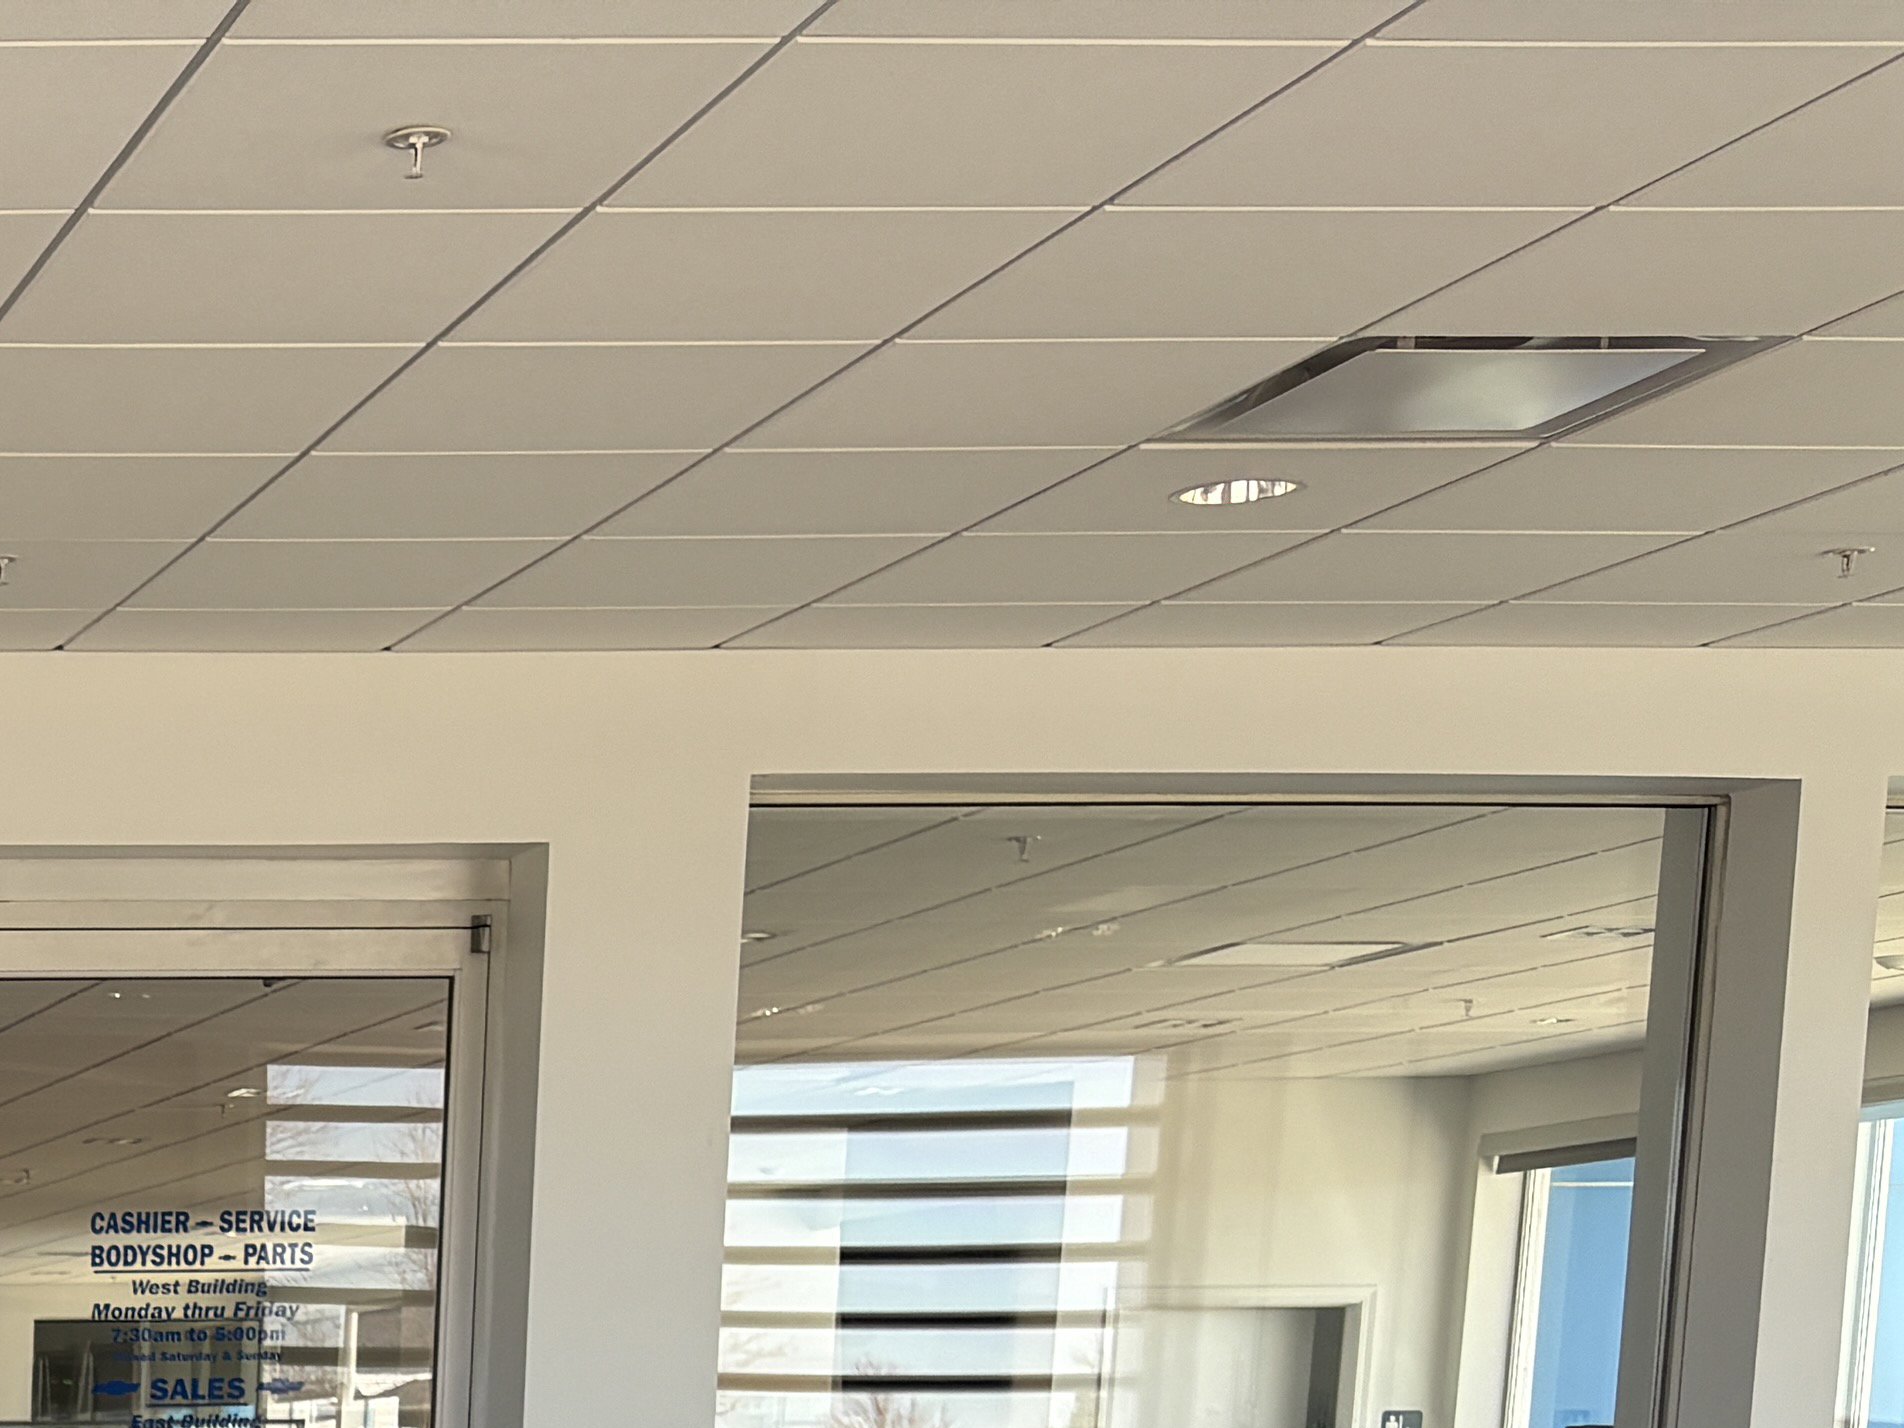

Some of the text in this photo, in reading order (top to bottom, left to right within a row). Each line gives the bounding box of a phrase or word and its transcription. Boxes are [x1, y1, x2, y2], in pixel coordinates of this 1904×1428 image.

[91, 1209, 316, 1234] CASHIER SERVICE
[91, 1242, 313, 1267] BODYSHOP PARTS
[132, 1279, 268, 1297] West Building
[92, 1302, 299, 1321] Monday thru Friday
[111, 1328, 181, 1343] 7:30am
[186, 1328, 207, 1342] to
[161, 1351, 216, 1363] Saturday
[237, 1351, 281, 1363] Sunday
[150, 1378, 245, 1400] SALES
